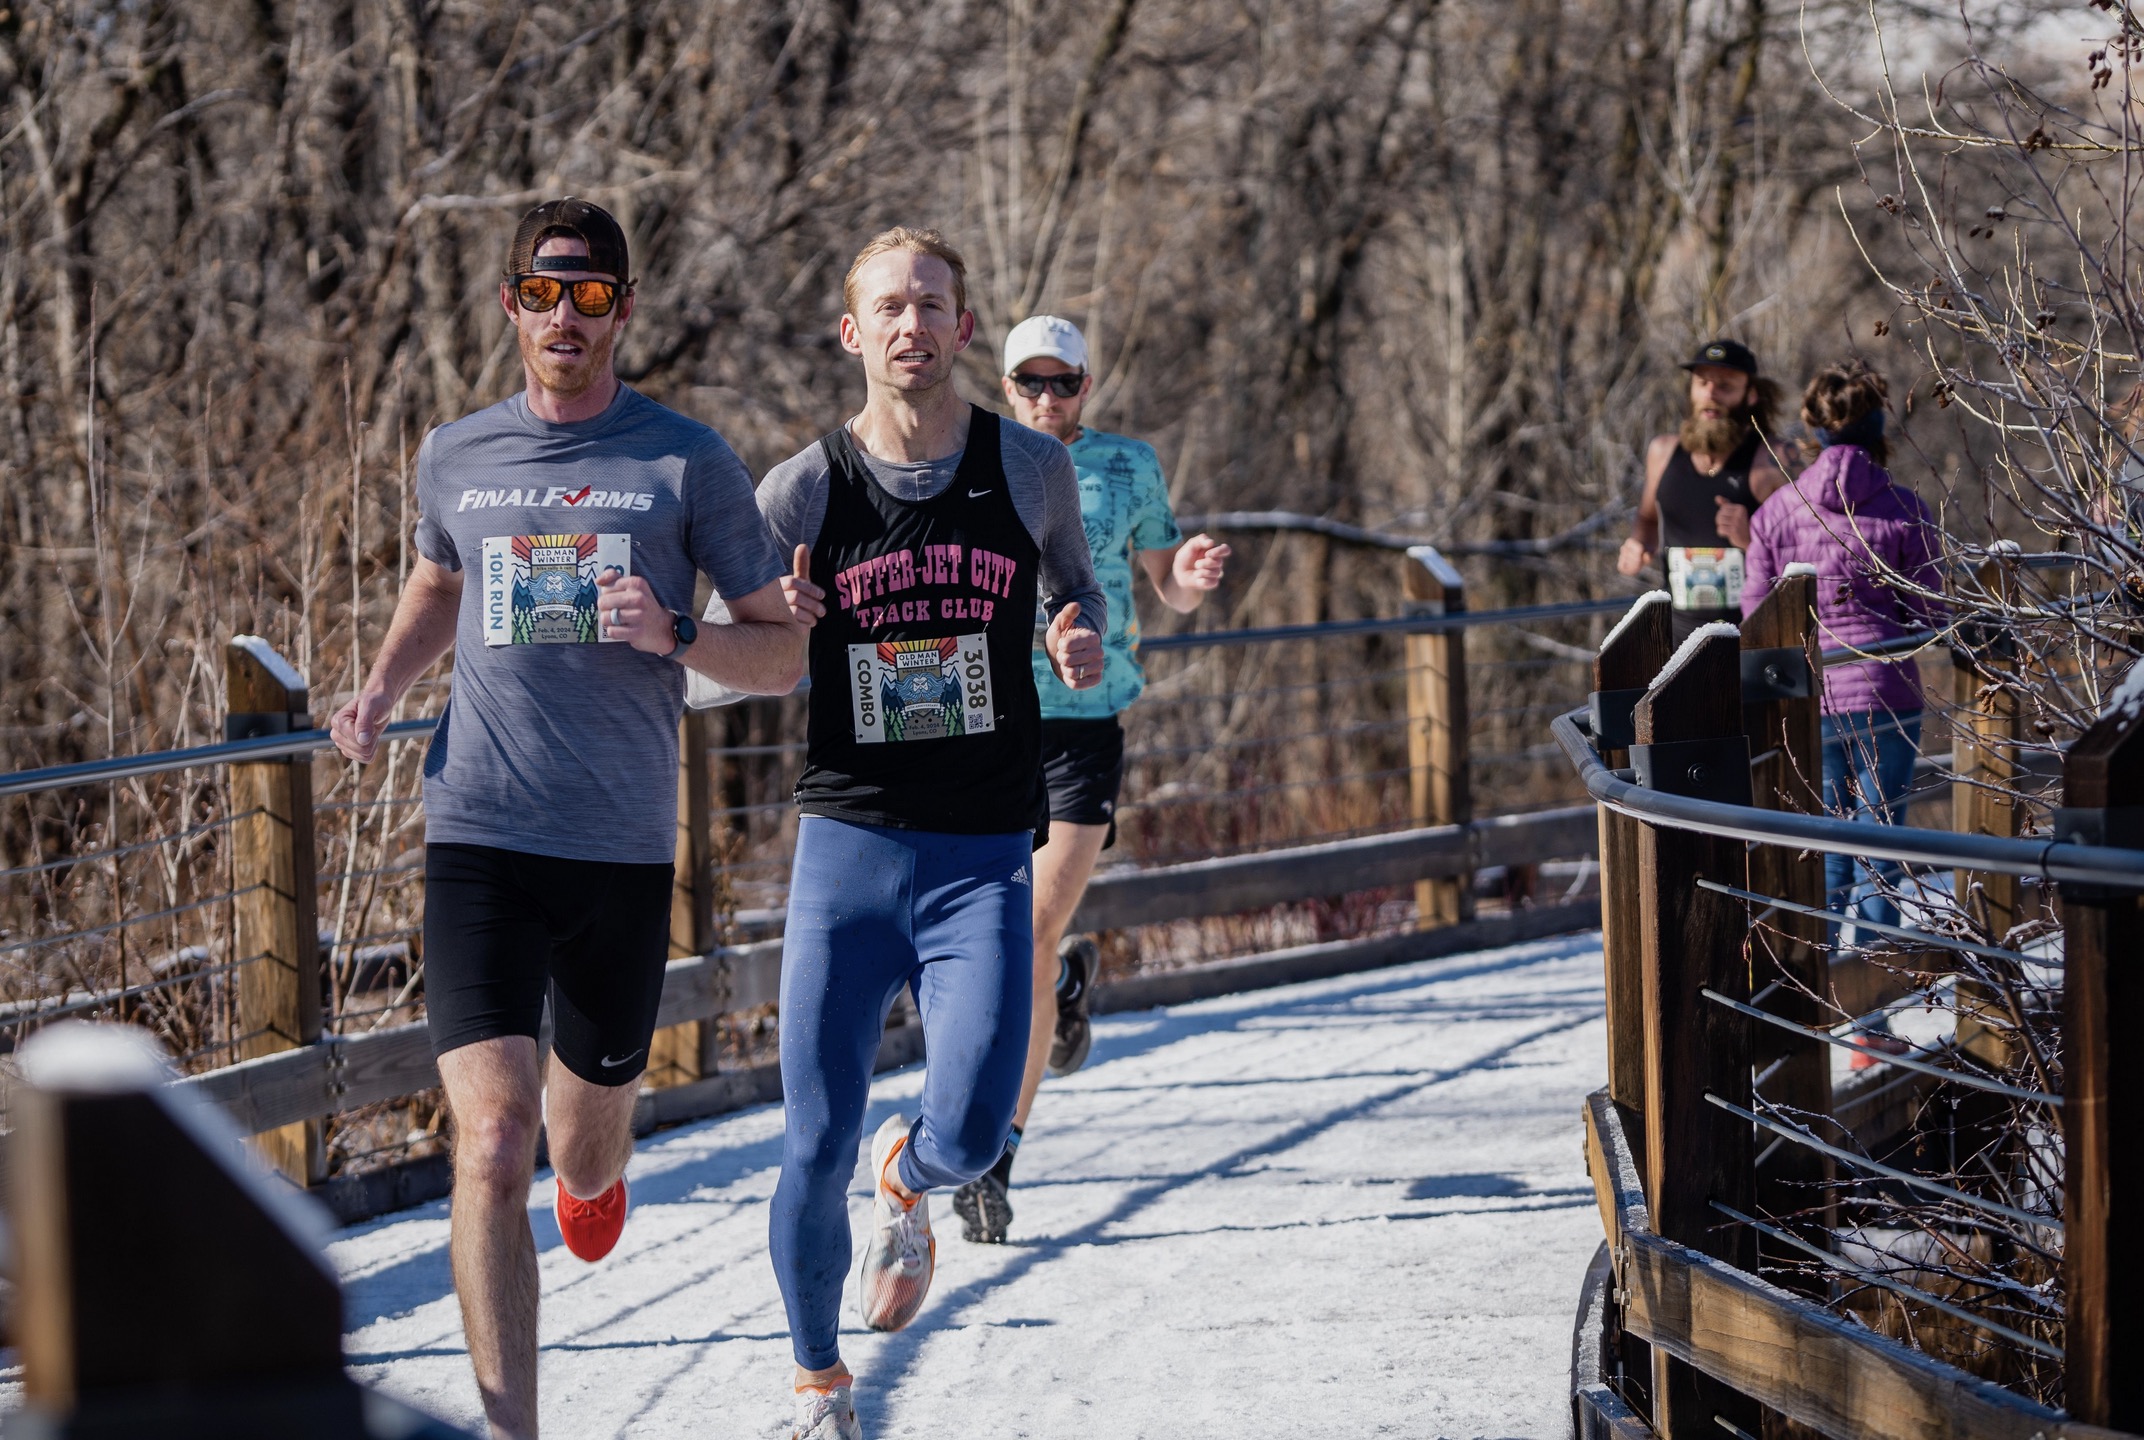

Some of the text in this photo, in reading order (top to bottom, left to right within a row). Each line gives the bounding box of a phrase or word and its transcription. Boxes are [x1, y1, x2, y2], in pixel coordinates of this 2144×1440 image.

[457, 486, 655, 512] FINALFORMS
[489, 552, 503, 630] 10K RUN
[834, 544, 1016, 610] SUFFER-JET CITY
[856, 598, 995, 628] TRACK CLUB
[902, 658, 935, 667] WINTER
[917, 651, 938, 660] MAN
[857, 659, 876, 727] COMBO
[964, 650, 987, 709] 3038
